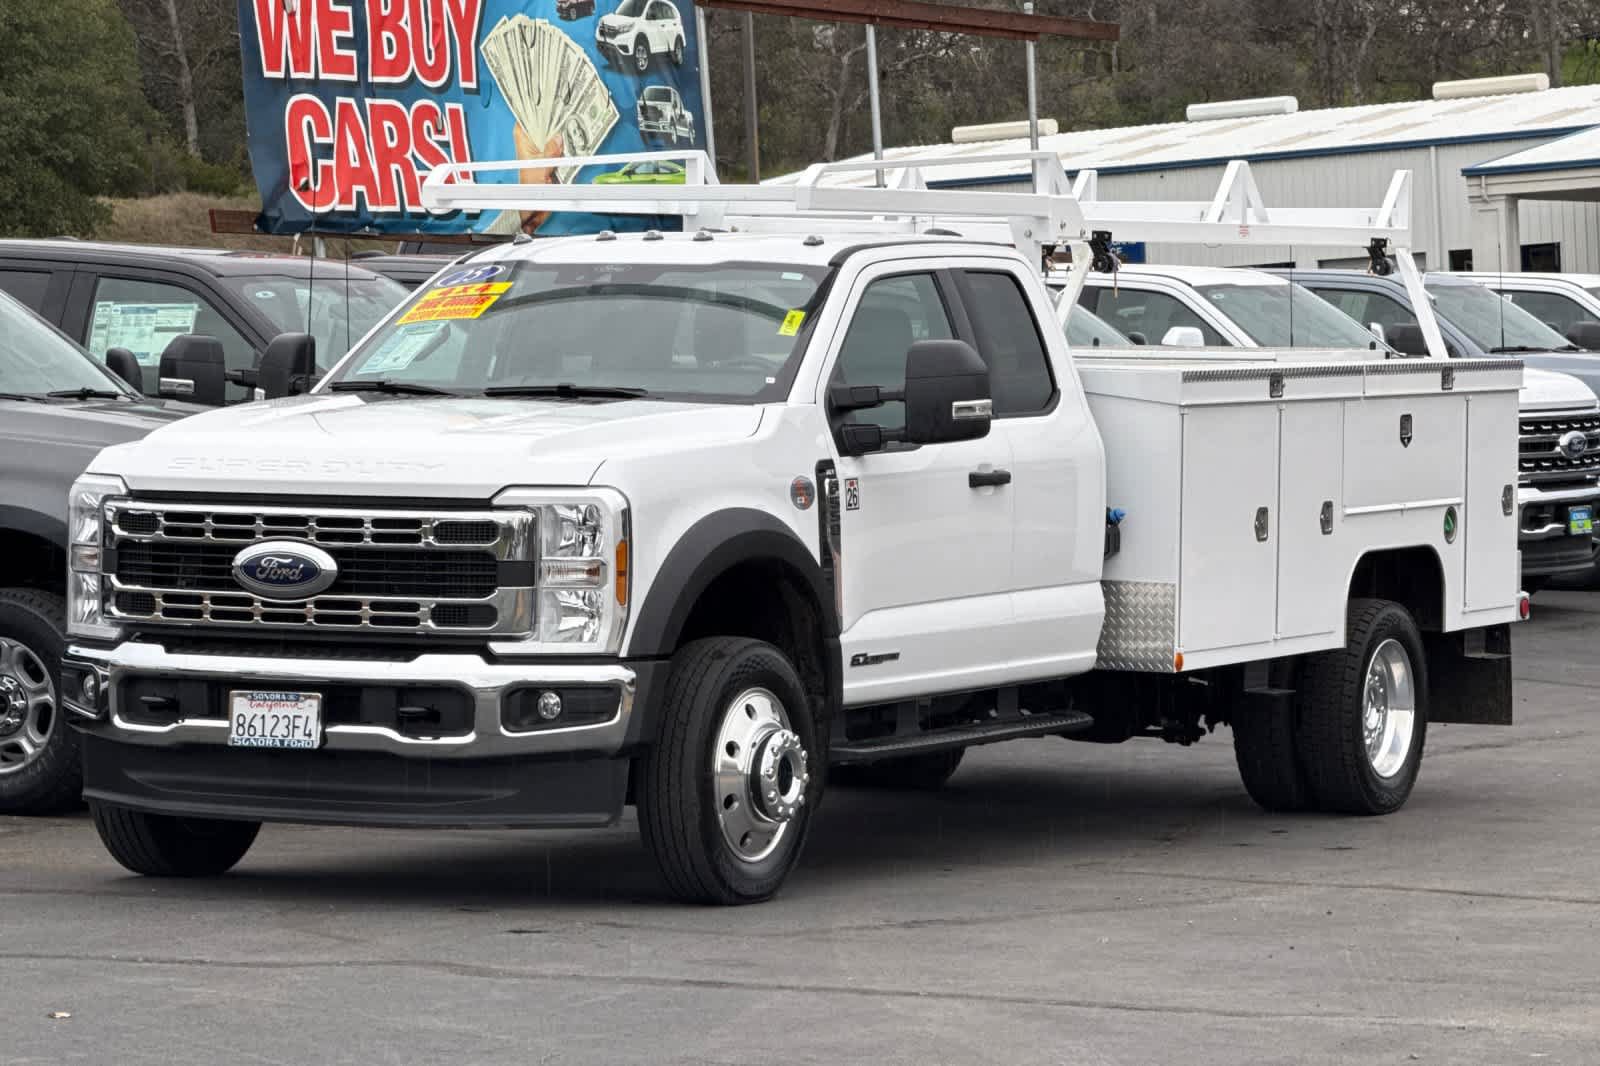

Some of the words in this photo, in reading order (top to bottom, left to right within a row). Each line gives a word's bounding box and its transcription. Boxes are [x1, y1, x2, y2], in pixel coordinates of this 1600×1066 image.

[254, 0, 358, 81] WE
[366, 0, 482, 88] BUY
[283, 94, 481, 215] CARS!
[847, 487, 858, 507] 26
[256, 556, 304, 581] Ford
[235, 713, 313, 739] 86123F4
[232, 737, 281, 747] SONORA
[284, 739, 313, 749] FORD
